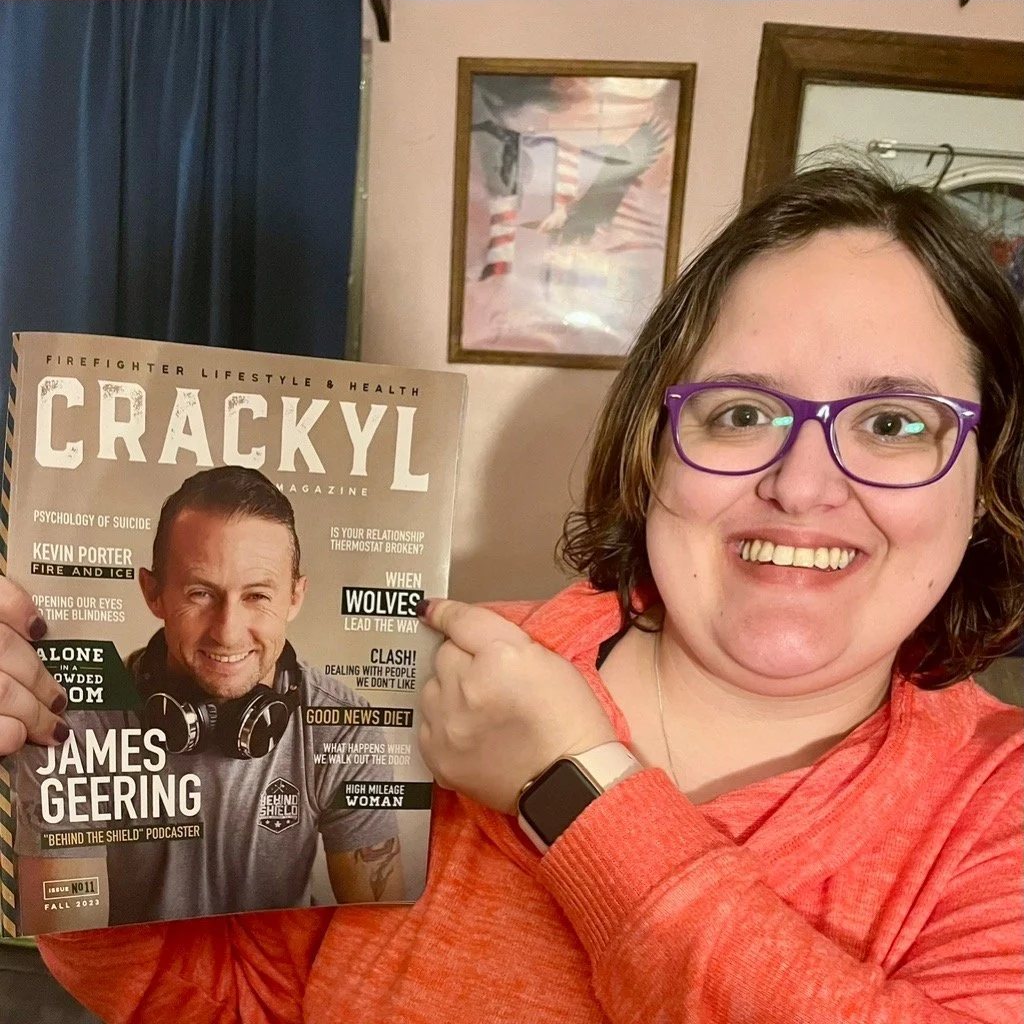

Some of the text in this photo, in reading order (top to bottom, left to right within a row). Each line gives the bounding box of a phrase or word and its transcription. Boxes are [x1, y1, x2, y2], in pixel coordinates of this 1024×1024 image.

[45, 354, 419, 397] FIREFIGHTER LIFESTYLE & HEALTH
[34, 376, 430, 492] CRACKYL
[275, 483, 369, 497] MAGAZINE
[33, 509, 151, 530] PSYCHOLOGY OF SUICIDE
[330, 526, 425, 543] IS YOUR RELATIONSHIP
[33, 542, 132, 565] KEVIN PORTER
[330, 539, 424, 555] THERMOSTAT BROKEN?
[32, 563, 133, 578] FIRE AND ICE
[385, 571, 422, 589] WHEN
[32, 594, 123, 610] OPENING OUR EYES
[345, 589, 420, 616] WOLVES
[46, 609, 69, 621] TIME
[71, 609, 125, 623] BLINDNESS
[344, 617, 419, 634] LEAD THE WAY
[37, 647, 104, 663] ALONE
[370, 648, 417, 666] CLASH!
[54, 674, 103, 684] OWDED
[325, 664, 416, 678] DEALING WITH PEOPLE
[356, 677, 415, 689] WE DON'T LIKE
[67, 687, 104, 703] OM
[306, 708, 411, 726] GOOD NEWS DIET
[36, 728, 167, 775] JAMES
[323, 742, 411, 754] WHAT HAPPENS WHEN
[314, 755, 410, 765] WE WALK OUT THE DOOR
[345, 784, 405, 795] HIGH MILEAGE
[40, 774, 201, 824] GEERING
[260, 794, 298, 808] BEHIND
[345, 795, 404, 807] WOMAN
[259, 805, 298, 816] SHIELD
[86, 831, 104, 844] THE
[146, 825, 200, 840] PODCASTER
[48, 885, 69, 894] ISSUE
[44, 899, 100, 910] FALL 2023
